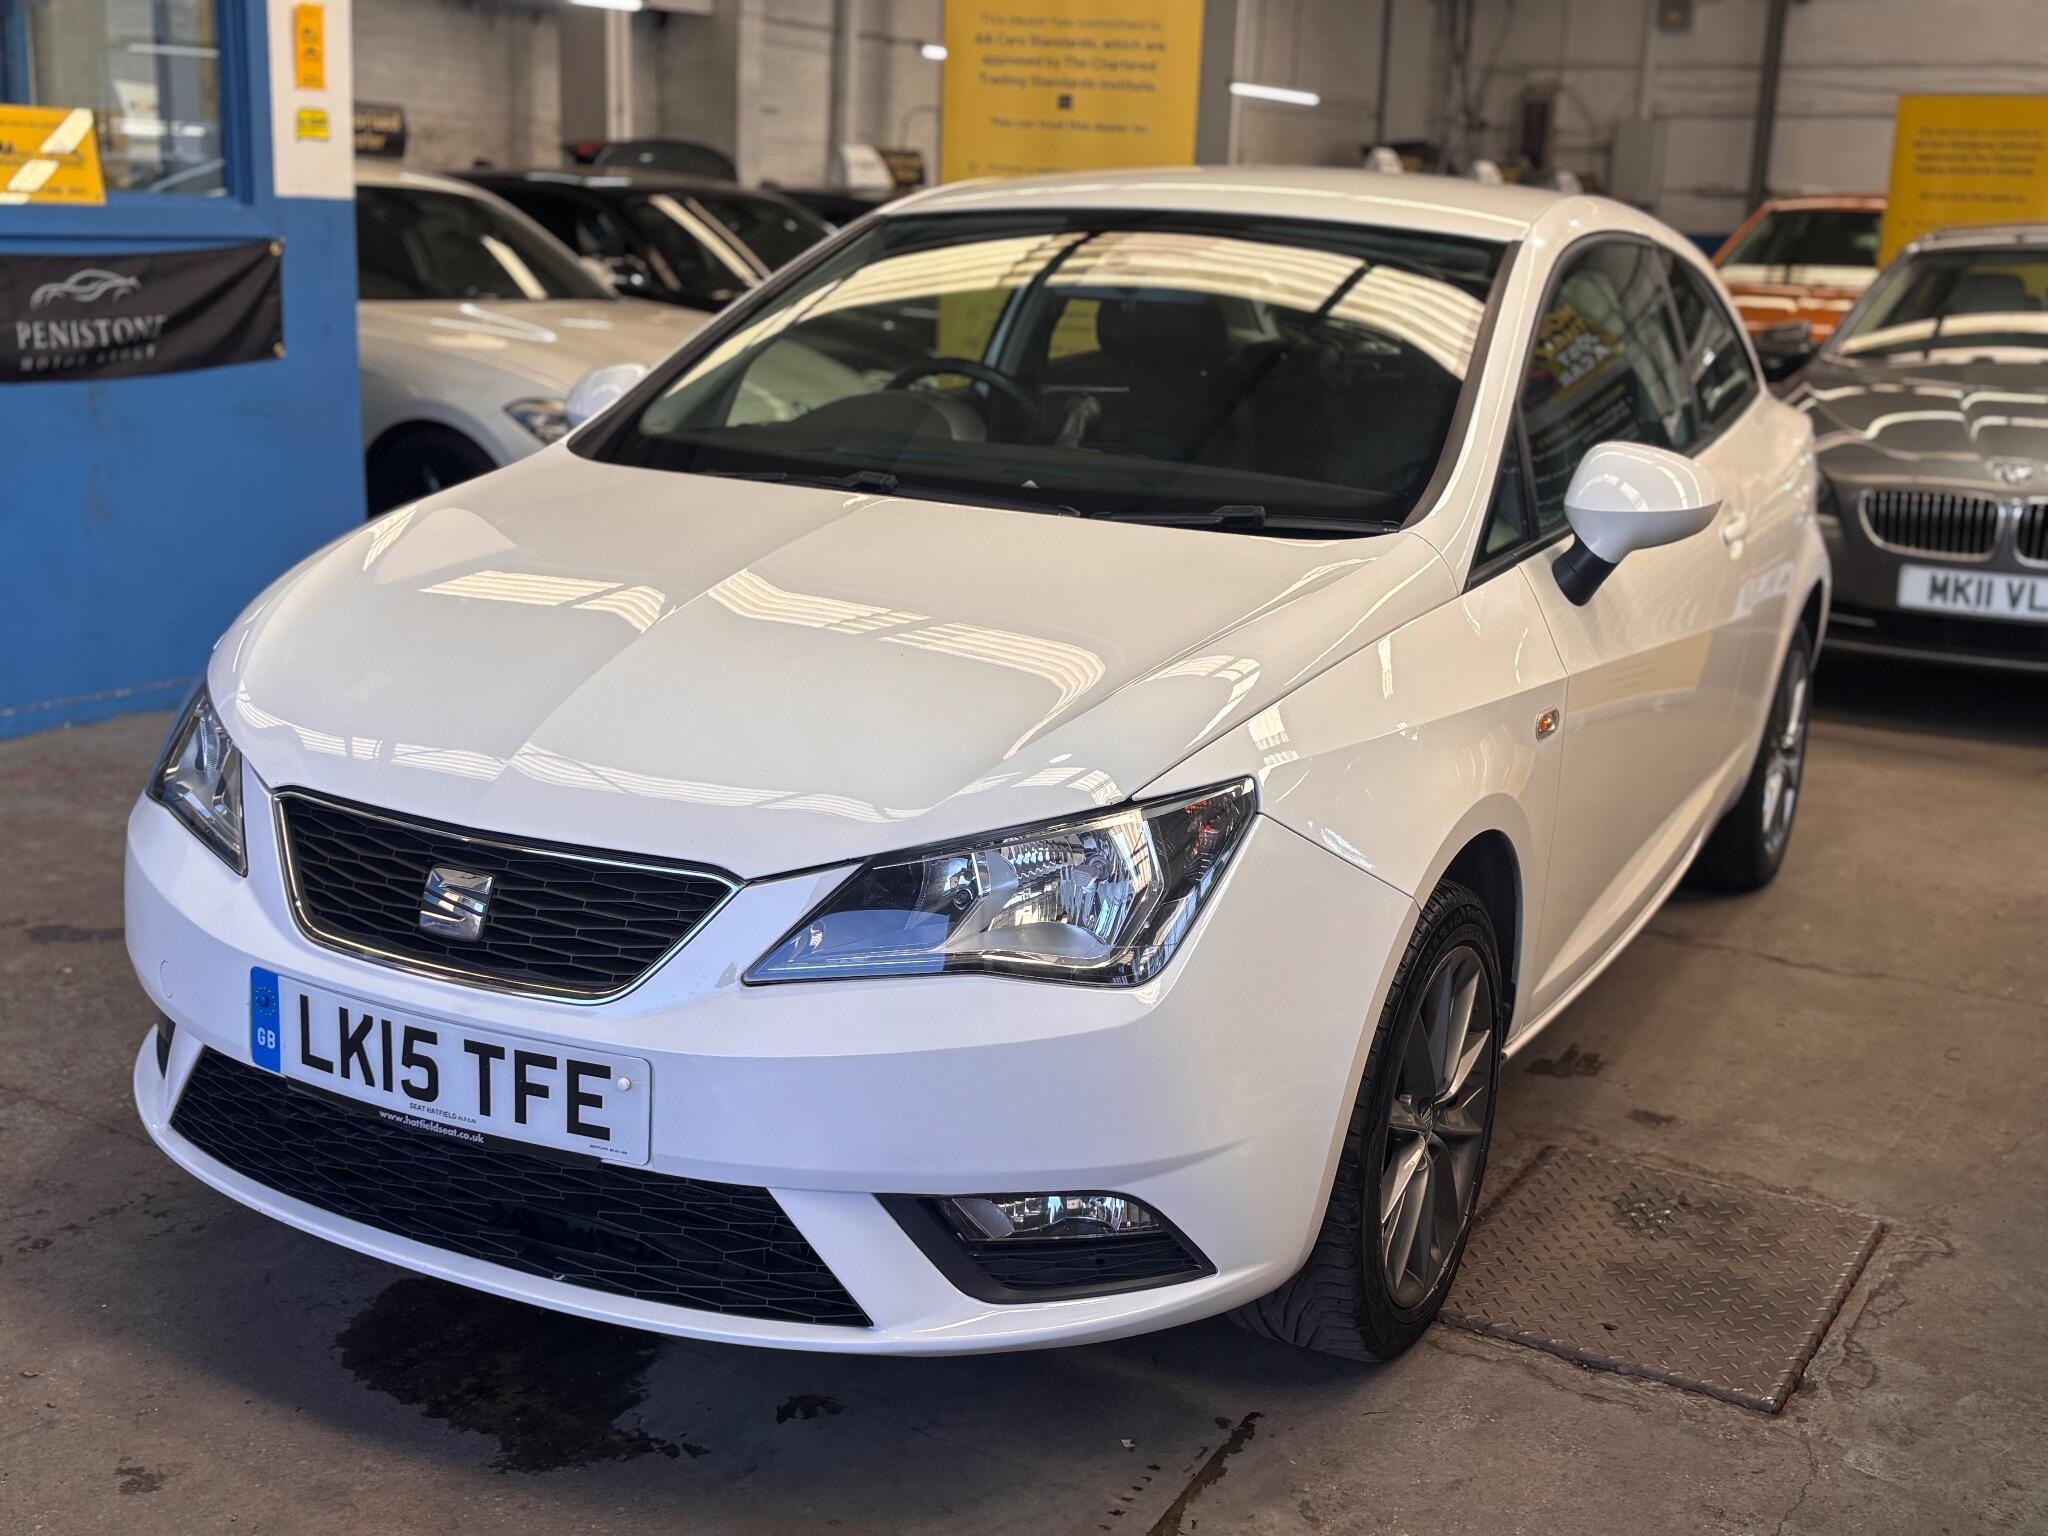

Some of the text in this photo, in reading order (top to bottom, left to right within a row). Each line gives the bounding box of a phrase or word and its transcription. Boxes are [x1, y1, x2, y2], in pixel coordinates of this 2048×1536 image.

[257, 1026, 277, 1050] GB
[299, 994, 612, 1141] LK15 TFE
[409, 1102, 426, 1112] SEAT
[426, 1107, 457, 1120] HATFIELD
[379, 1110, 485, 1144] www.hatfieldseat.co.uk
